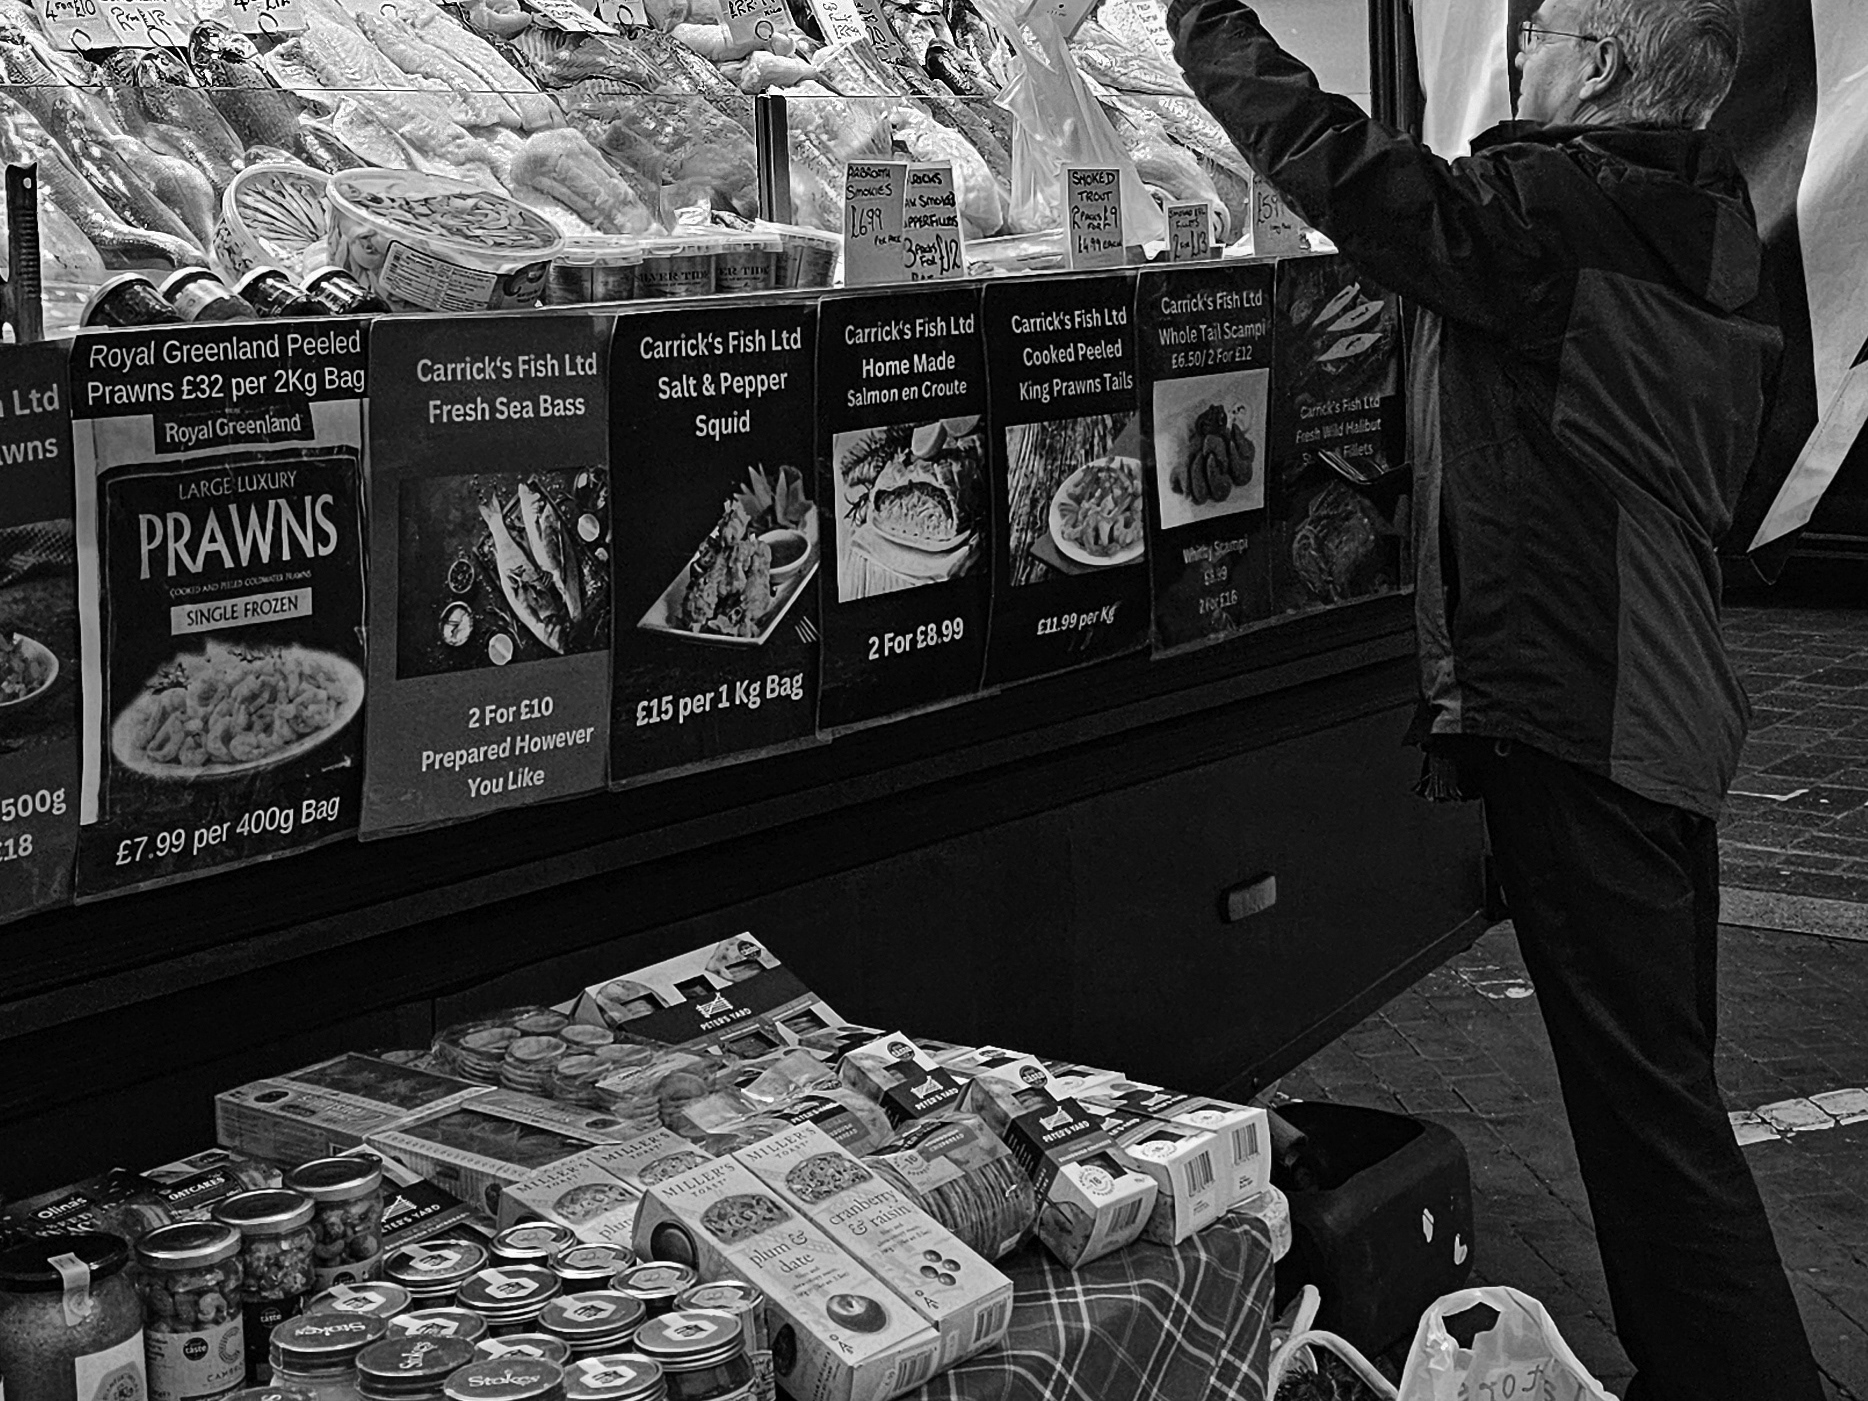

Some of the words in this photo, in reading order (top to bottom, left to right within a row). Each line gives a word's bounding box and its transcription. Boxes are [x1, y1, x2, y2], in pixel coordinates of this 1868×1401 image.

[46, 1, 58, 22] 4
[55, 1, 74, 10] FOR
[846, 183, 893, 201] SMOKIES
[1072, 170, 1116, 186] SMOKED
[1077, 190, 1113, 202] TROUT
[1071, 205, 1081, 230] 2
[904, 237, 917, 268] 3
[920, 255, 938, 267] FOR
[935, 233, 961, 275] £12
[1216, 290, 1241, 311] Fish
[1243, 288, 1264, 309] Ltd
[845, 319, 912, 346] Carrick's
[915, 315, 947, 339] Fish
[951, 312, 975, 336] Ltd
[1011, 311, 1072, 335] Carrick's
[1074, 308, 1101, 331] Fish
[1104, 305, 1128, 327] Ltd
[1158, 325, 1198, 347] Whole
[1199, 322, 1222, 343] Tail
[1223, 317, 1267, 342] Scampi
[90, 344, 155, 373] Royal
[162, 336, 281, 364] Greenland
[287, 330, 362, 356] Peeled
[640, 332, 724, 359] Carrick's
[729, 329, 767, 355] Fish
[771, 326, 802, 352] Ltd
[1023, 342, 1075, 368] Cooked
[1077, 338, 1123, 361] Peeled
[1216, 347, 1234, 364] For
[1235, 344, 1254, 362] £12
[417, 355, 513, 383] Carrick's
[518, 354, 560, 379] Fish
[564, 351, 598, 377] Ltd
[862, 357, 910, 380] Home
[913, 350, 956, 375] Made
[12, 383, 60, 417] Ltd
[87, 376, 175, 406] Prawns
[181, 373, 225, 400] £32
[231, 371, 268, 403] per
[274, 367, 318, 396] 2Kg
[324, 366, 366, 392] Bag
[658, 373, 698, 400] Salt
[702, 373, 716, 397] &
[720, 371, 788, 399] Pepper
[847, 386, 899, 408] Salmon
[902, 386, 919, 401] en
[922, 378, 968, 400] Croute
[1019, 379, 1051, 405] King
[1053, 376, 1101, 399] Prawns
[1102, 369, 1134, 392] Tails
[429, 397, 490, 424] Fresh
[495, 396, 535, 421] Sea
[539, 395, 586, 418] Bass
[1341, 395, 1362, 413] Fish
[164, 419, 213, 446] Royal
[215, 412, 302, 438] Greenland
[695, 409, 751, 442] Squid
[178, 479, 232, 500] LARGE
[237, 470, 298, 493] LUXURY
[139, 493, 339, 580] PRAWNS
[186, 601, 239, 627] SINGLE
[243, 594, 299, 619] FROZEN
[1036, 613, 1078, 635] £11.99
[1078, 609, 1100, 631] per
[1100, 604, 1116, 624] Kg
[869, 636, 880, 661] 2
[884, 632, 914, 657] For
[916, 617, 964, 651] £8.99
[469, 708, 480, 729] 2
[485, 704, 517, 727] For
[520, 696, 555, 721] £10
[636, 695, 673, 727] £15
[679, 689, 715, 724] per
[766, 673, 803, 700] Bag
[422, 738, 511, 772] Prepared
[515, 727, 595, 757] However
[468, 774, 504, 798] You
[508, 767, 545, 790] Like
[0, 787, 67, 821] 500g
[115, 828, 186, 866] £7.99
[192, 821, 231, 856] per
[236, 806, 295, 836] 400g
[301, 796, 341, 824] Bag
[699, 1014, 732, 1032] PETER'S
[731, 1007, 753, 1020] YARD
[1071, 1119, 1091, 1134] YARD
[601, 1132, 671, 1161] MILLER'S
[745, 1128, 817, 1162] MILLER'S
[168, 1176, 226, 1201] OATCAKES
[661, 1163, 736, 1199] MILLER'S
[411, 1204, 441, 1219] YARD
[828, 1190, 900, 1226] cranberry
[849, 1219, 868, 1236] &
[869, 1205, 912, 1228] raisin
[749, 1242, 792, 1270] plum
[788, 1230, 807, 1246] &
[779, 1254, 815, 1274] date
[467, 1368, 542, 1389] Stokes
